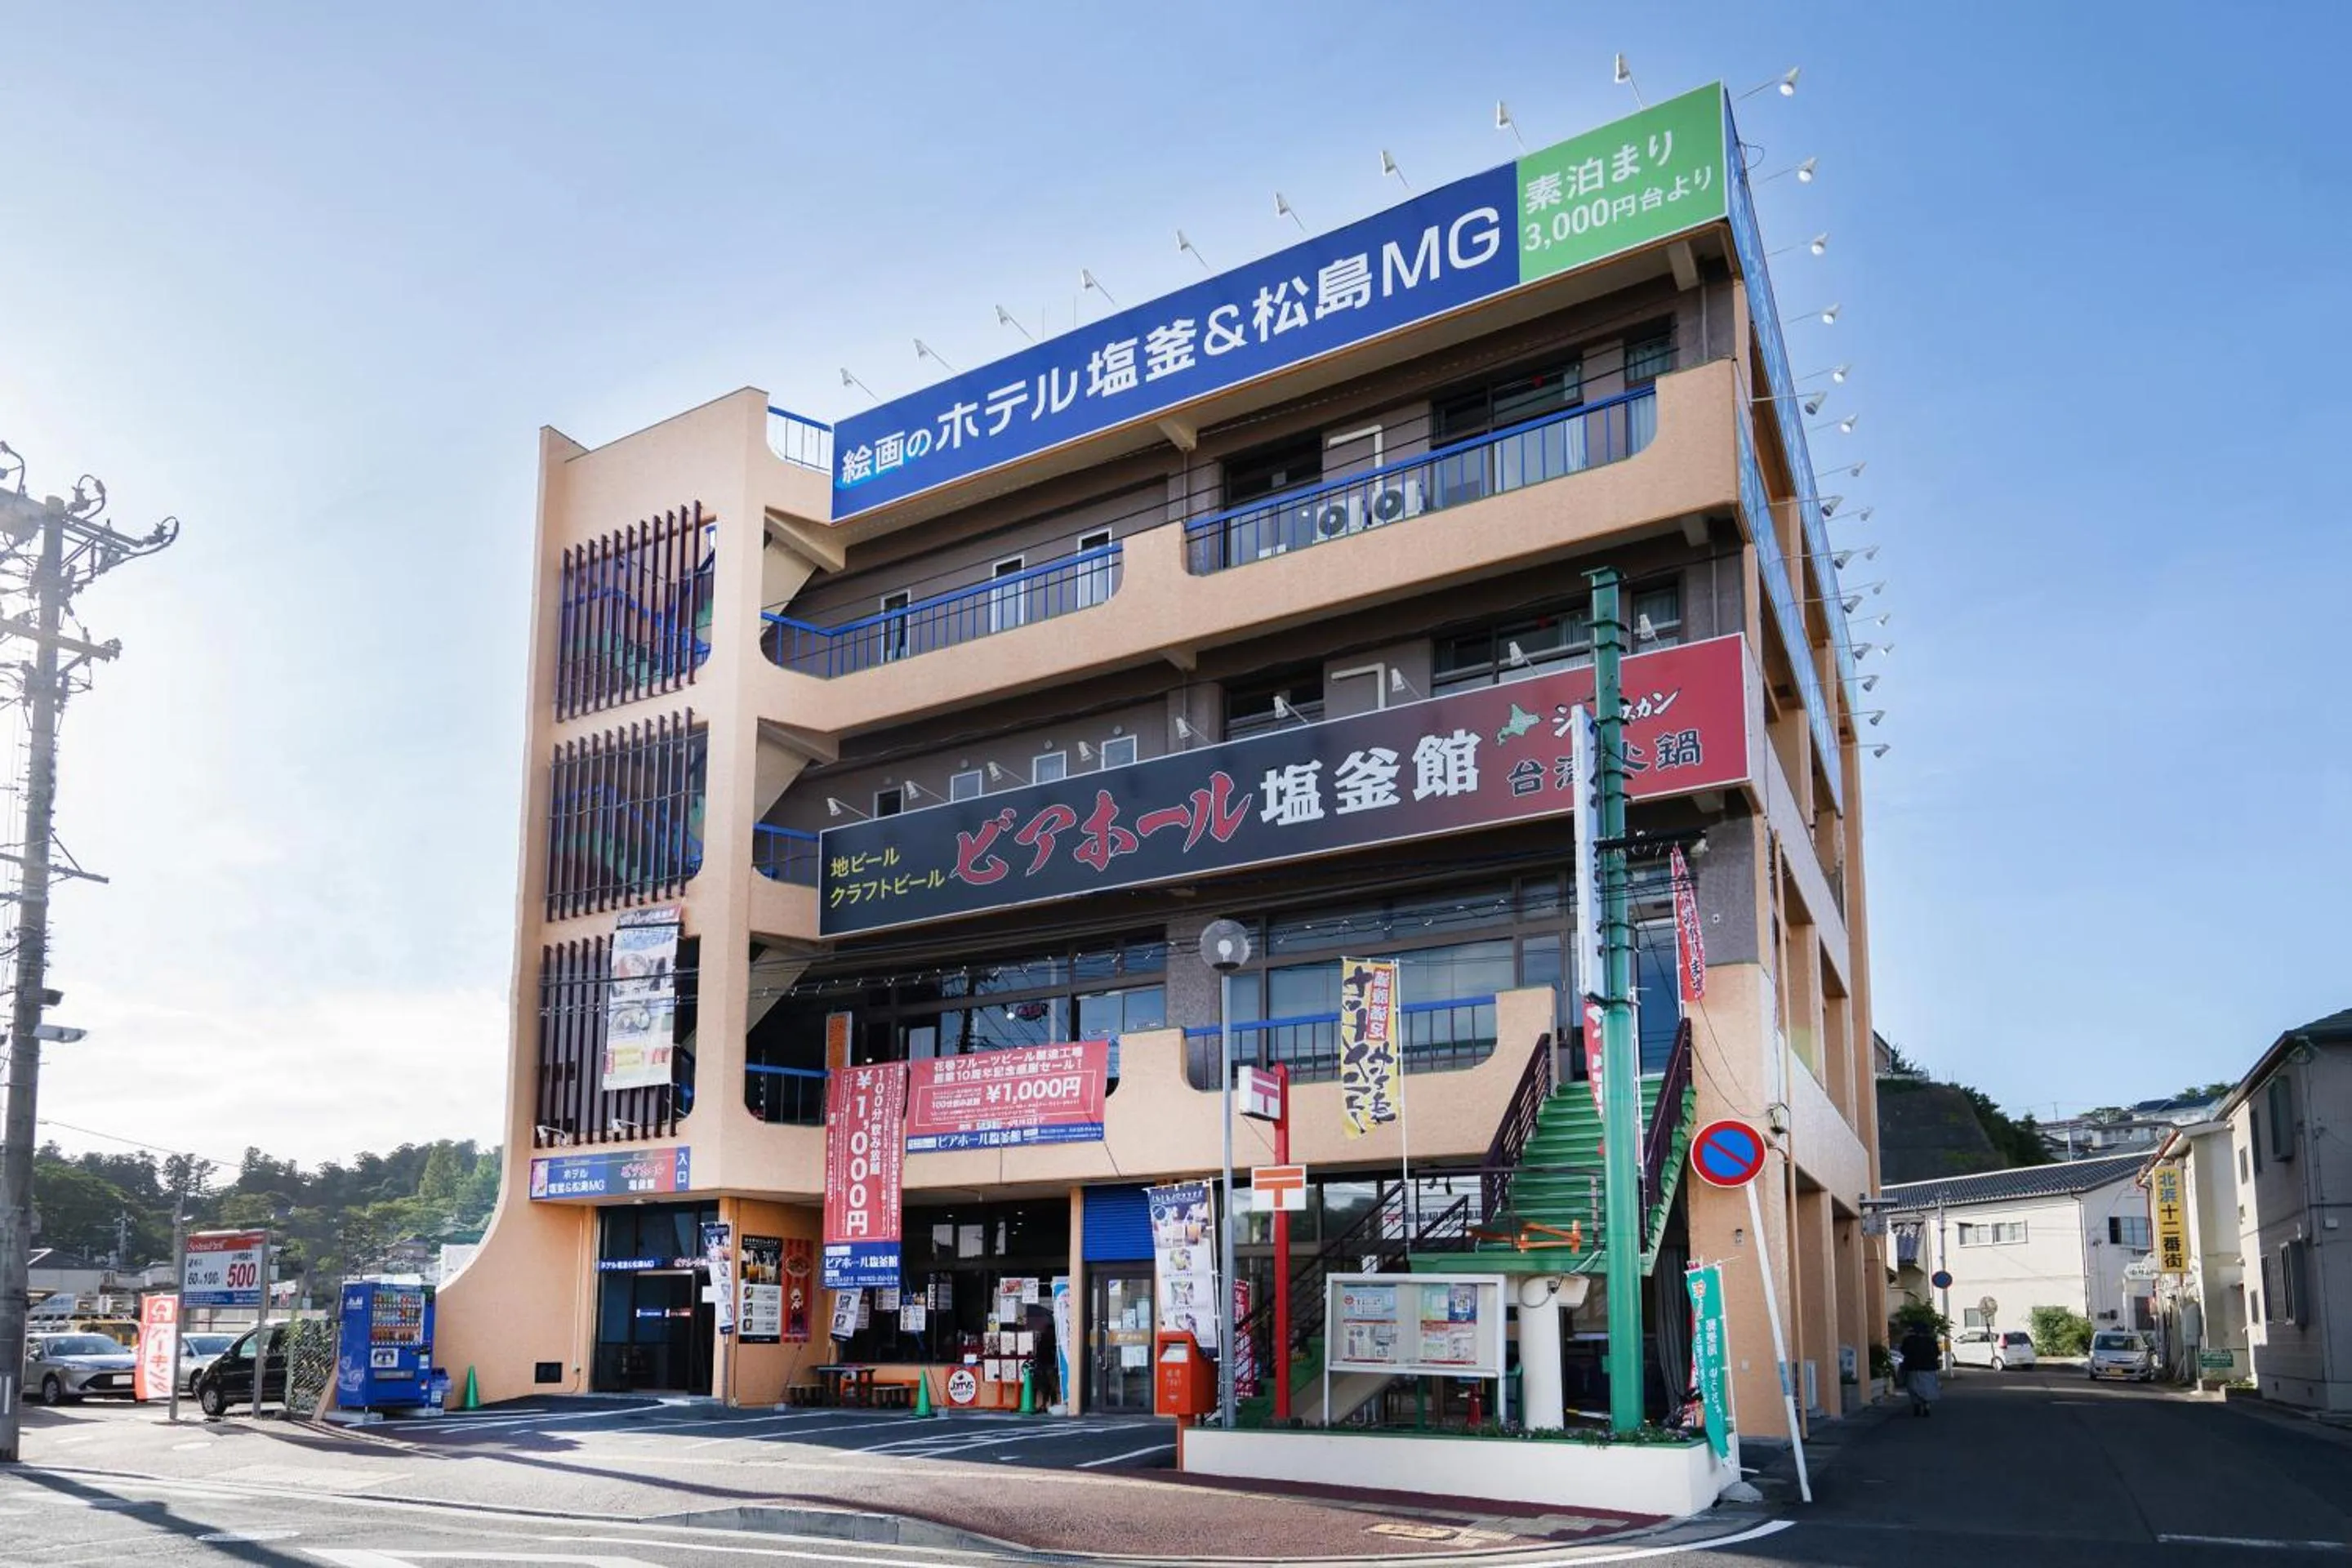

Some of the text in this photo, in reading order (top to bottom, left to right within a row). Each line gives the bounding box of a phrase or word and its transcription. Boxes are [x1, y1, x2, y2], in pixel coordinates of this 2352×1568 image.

[1524, 165, 1711, 251] 3,000円台より
[1525, 131, 1673, 215] 素泊まり
[842, 207, 1500, 483] 絵画のホテル塩釜&松島MG
[1260, 729, 1481, 826] 塩釜館
[830, 869, 945, 909] クラフトビール
[831, 848, 899, 878] 地ビール
[987, 1076, 1081, 1105] ¥1,000円
[677, 1153, 688, 1183] 入口
[846, 1070, 873, 1236] ¥1,000円
[2158, 1171, 2182, 1268] 北浜十二番街
